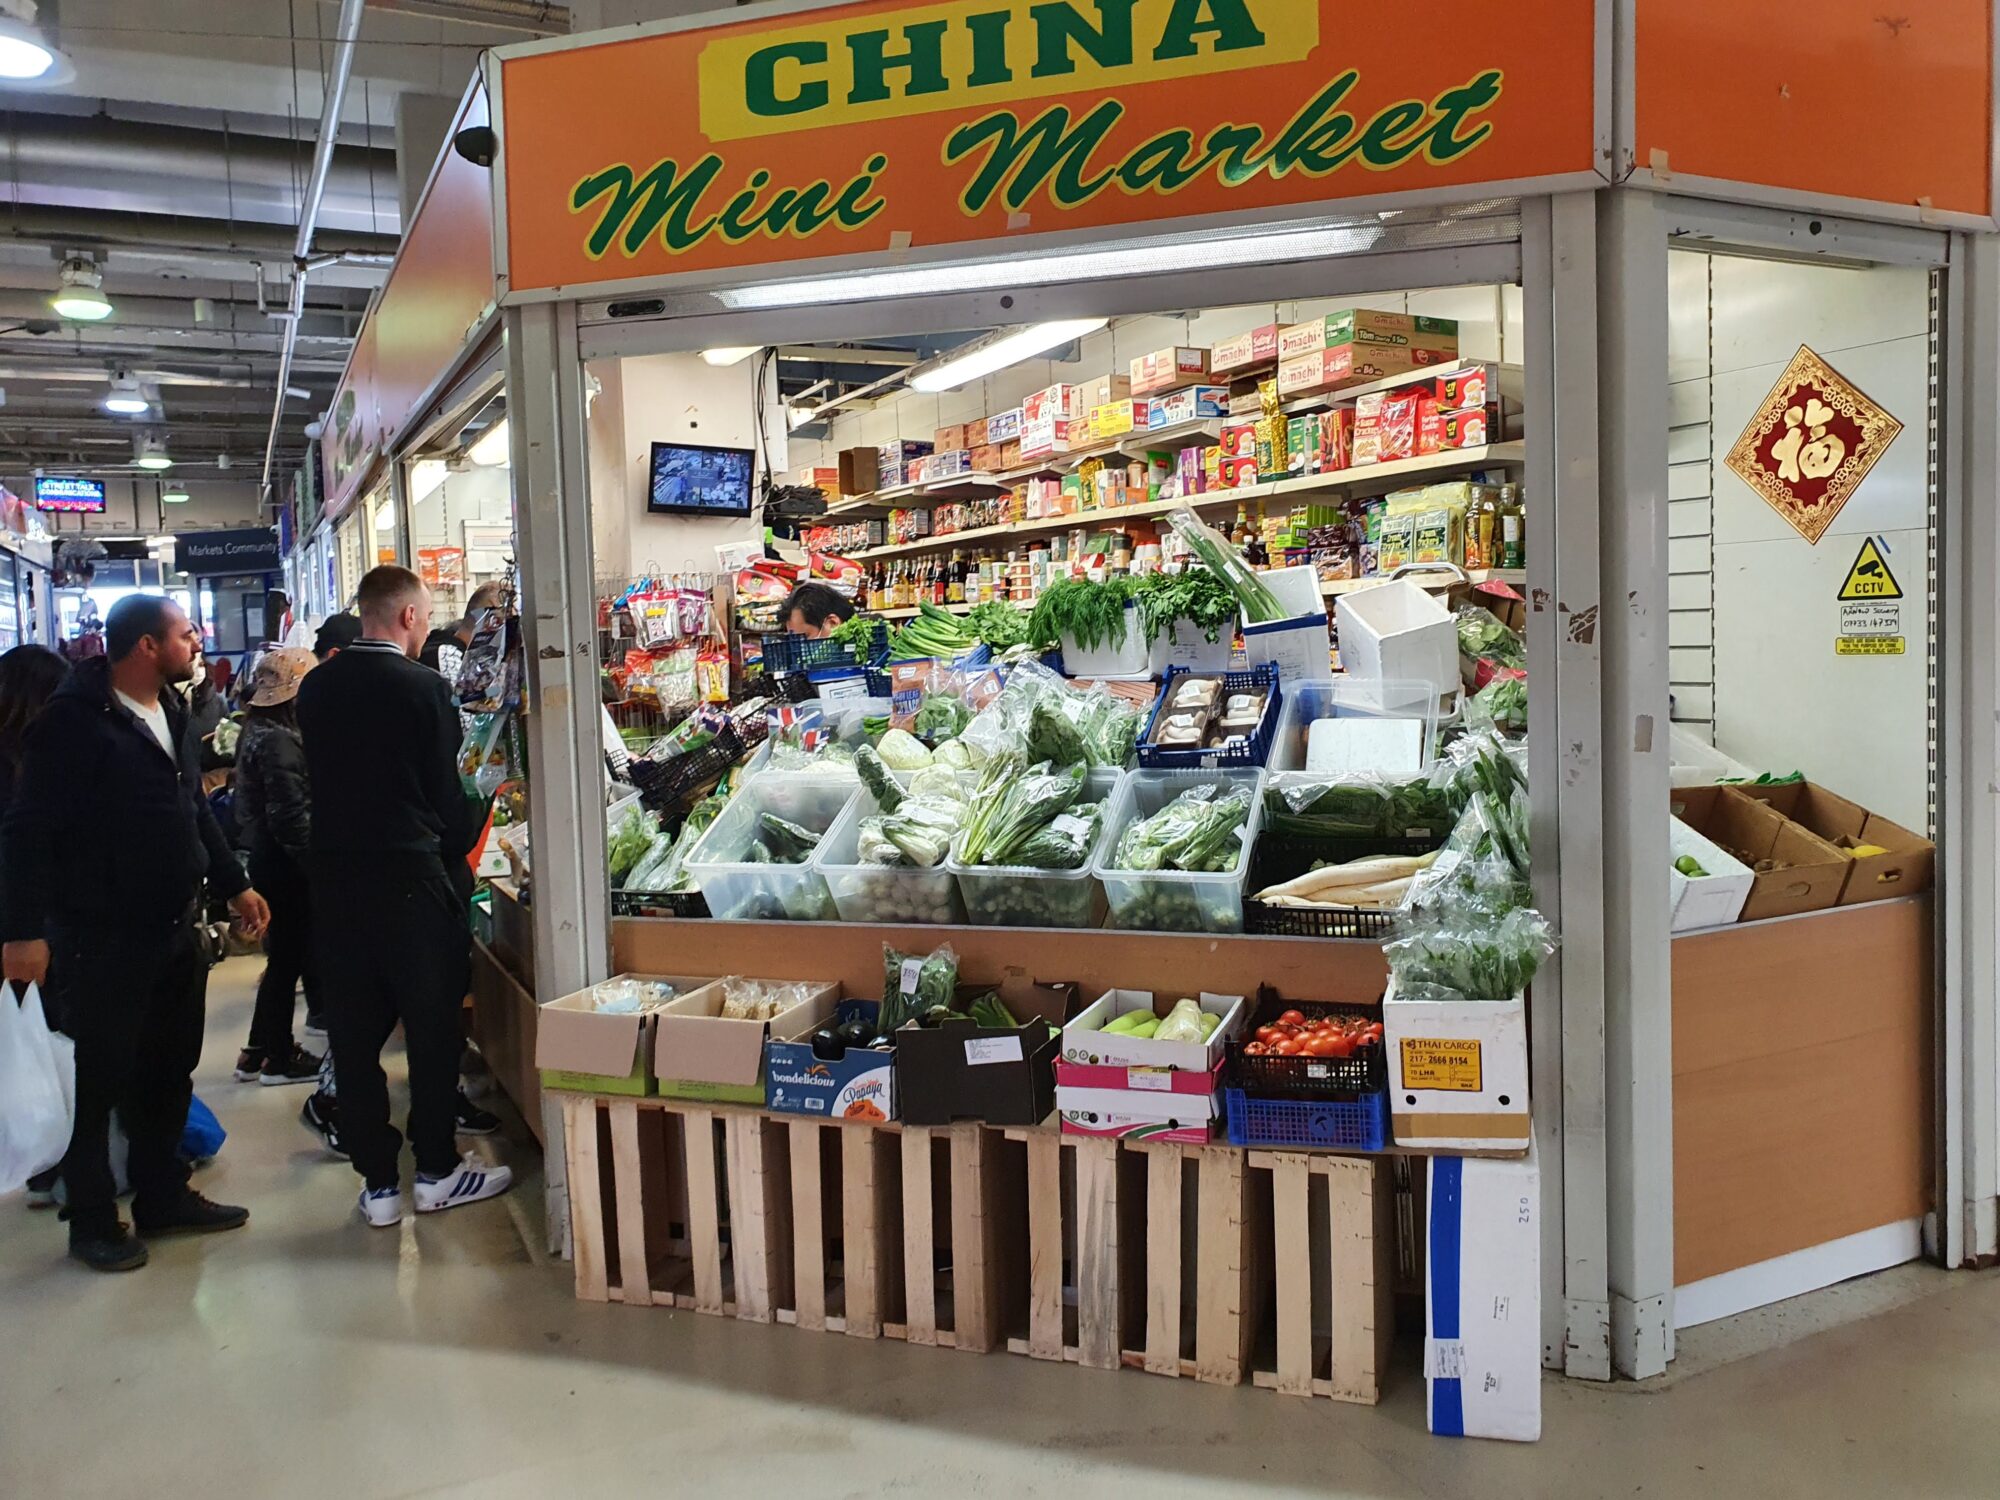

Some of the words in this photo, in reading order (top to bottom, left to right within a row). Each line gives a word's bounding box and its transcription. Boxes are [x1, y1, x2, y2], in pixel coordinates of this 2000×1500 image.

[745, 0, 1265, 117] CHINA
[568, 152, 888, 262] Mini
[941, 67, 1504, 218] Market
[1771, 398, 1846, 484] 福
[187, 544, 223, 557] Markets
[224, 541, 277, 555] Community
[1855, 582, 1884, 594] CCTV
[1417, 1040, 1441, 1049] THAI
[1443, 1041, 1477, 1050] CARGO
[771, 1069, 836, 1087] bondelicious
[843, 1081, 885, 1109] Papaya
